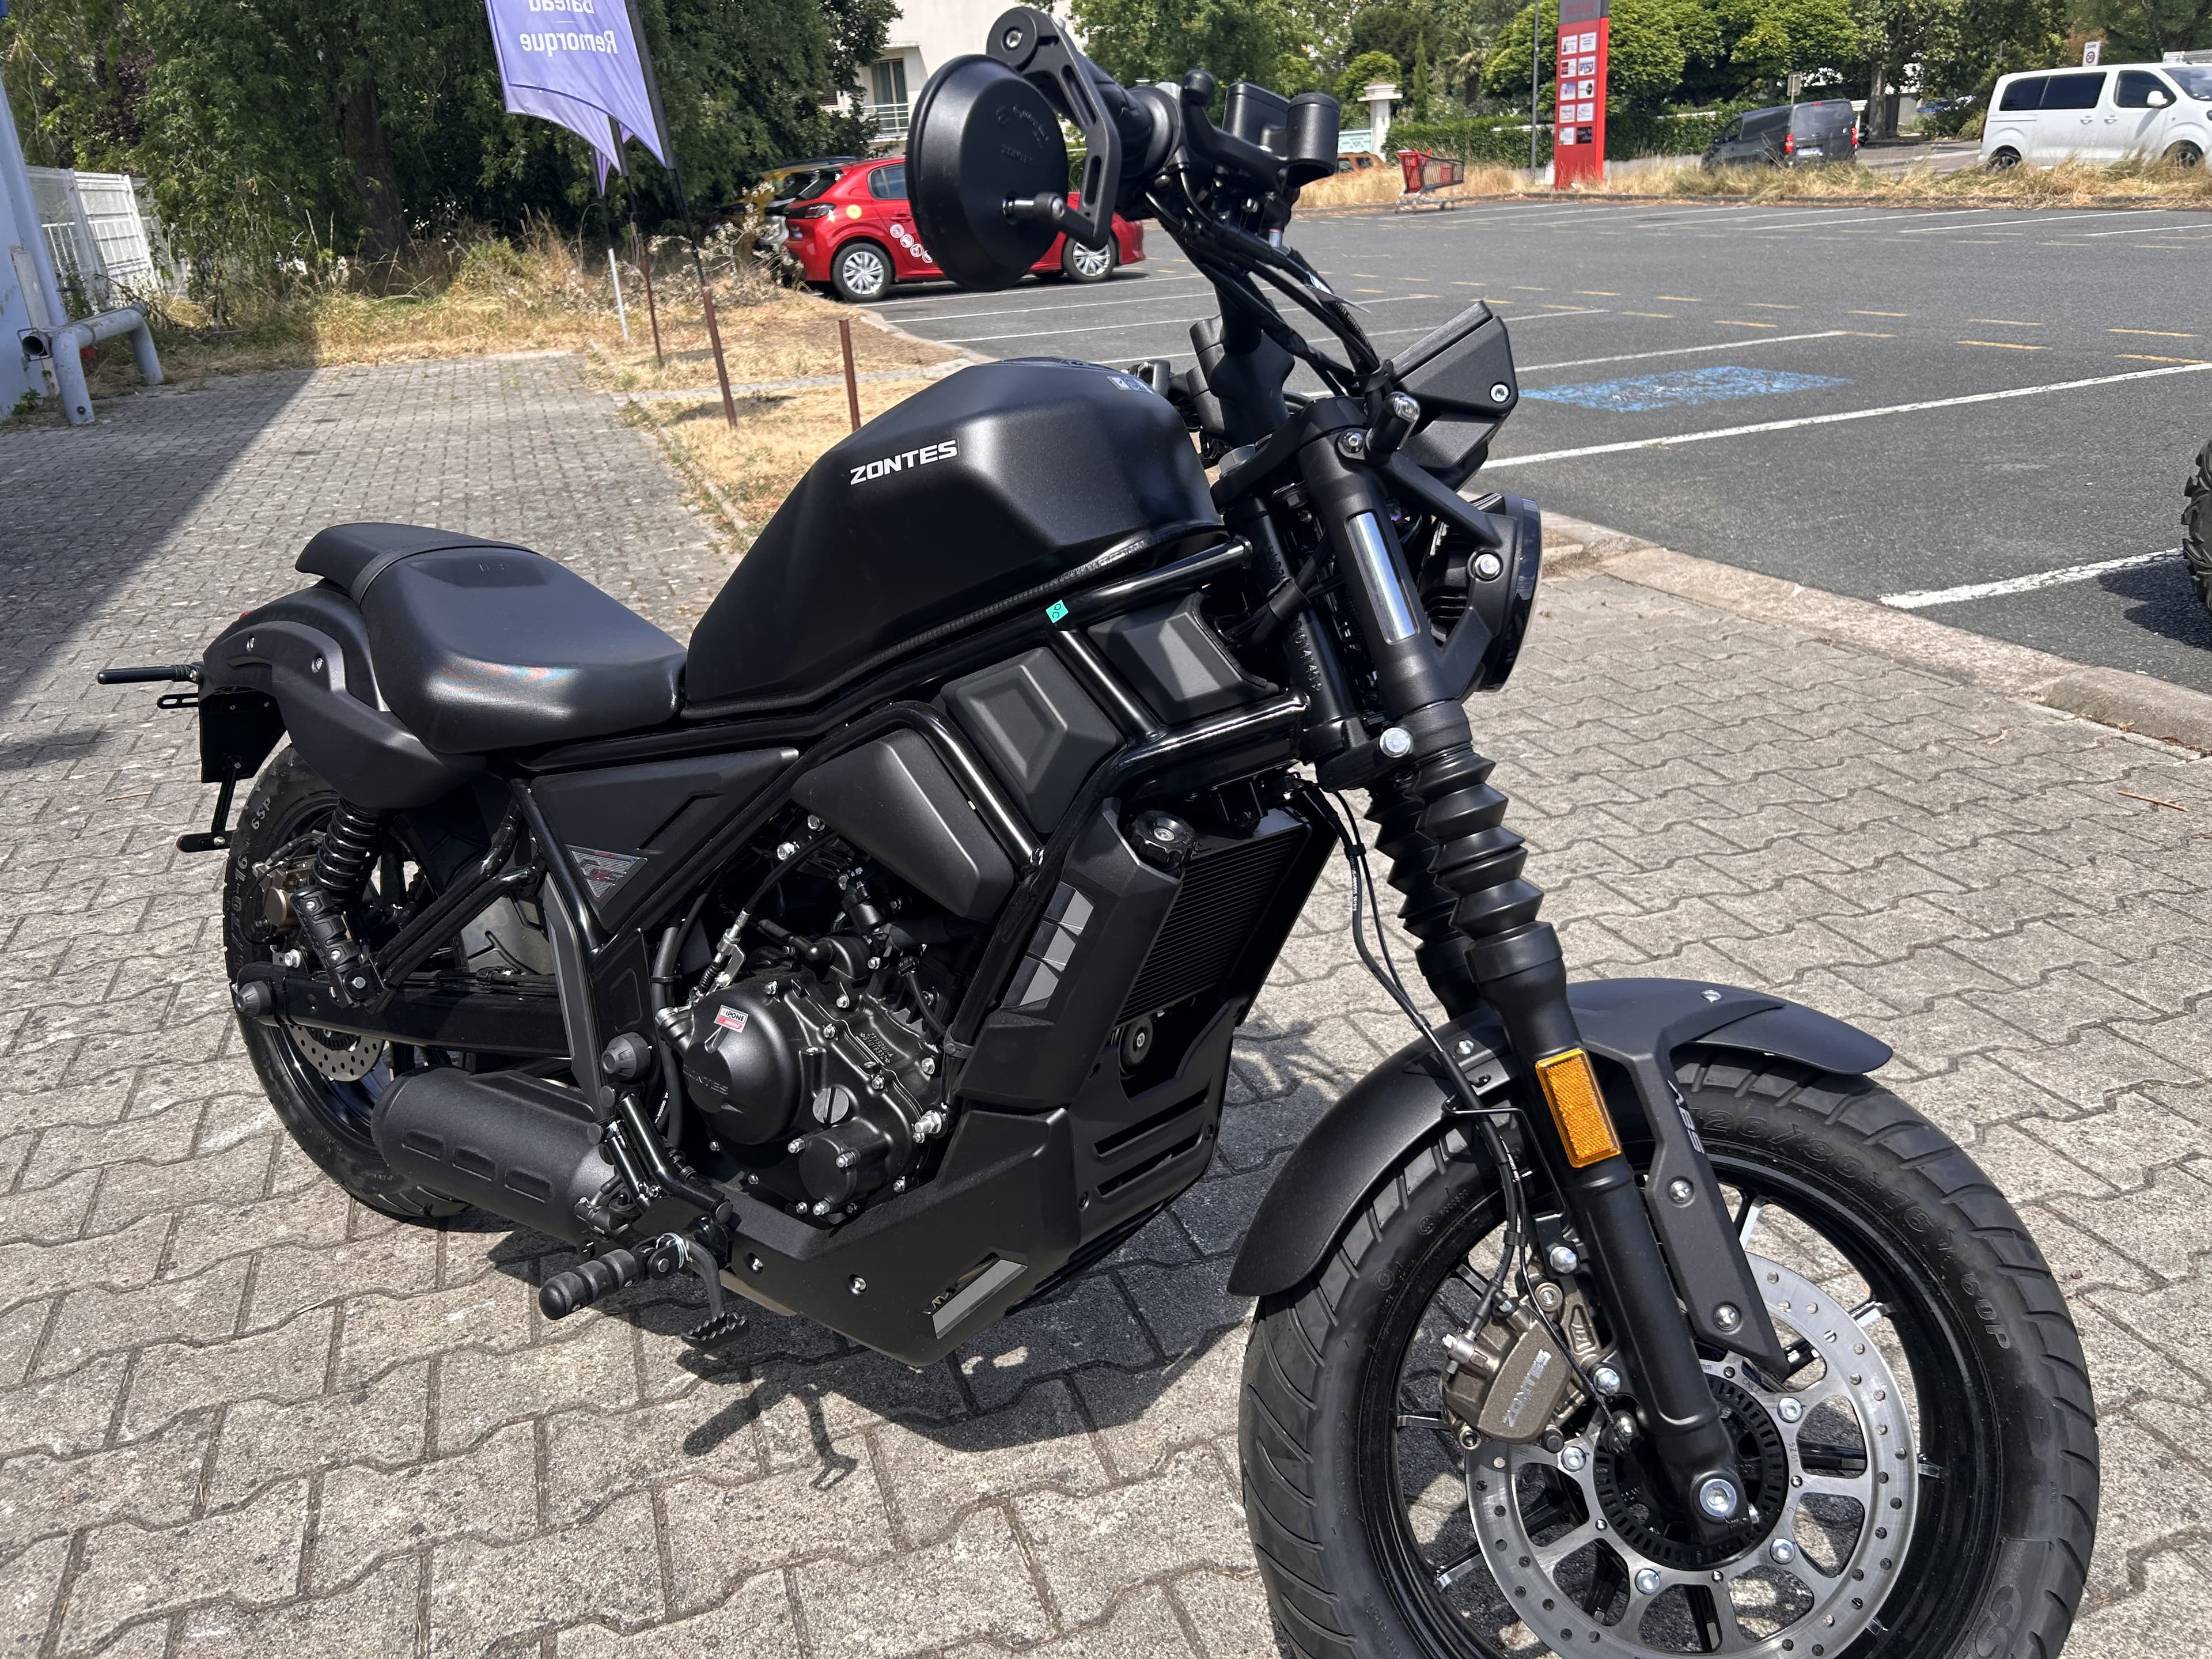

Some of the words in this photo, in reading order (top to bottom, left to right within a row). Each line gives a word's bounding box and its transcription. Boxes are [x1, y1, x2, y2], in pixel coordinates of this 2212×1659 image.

[849, 439, 958, 486] ZONTES
[1052, 603, 1062, 618] QC
[251, 797, 271, 830] 65P
[725, 1010, 745, 1022] IPONE
[1667, 1079, 1705, 1155] ABS
[1689, 1107, 1934, 1232] 20/80-16
[1960, 1272, 2013, 1350] 60P
[1502, 1347, 1552, 1429] ZONTES
